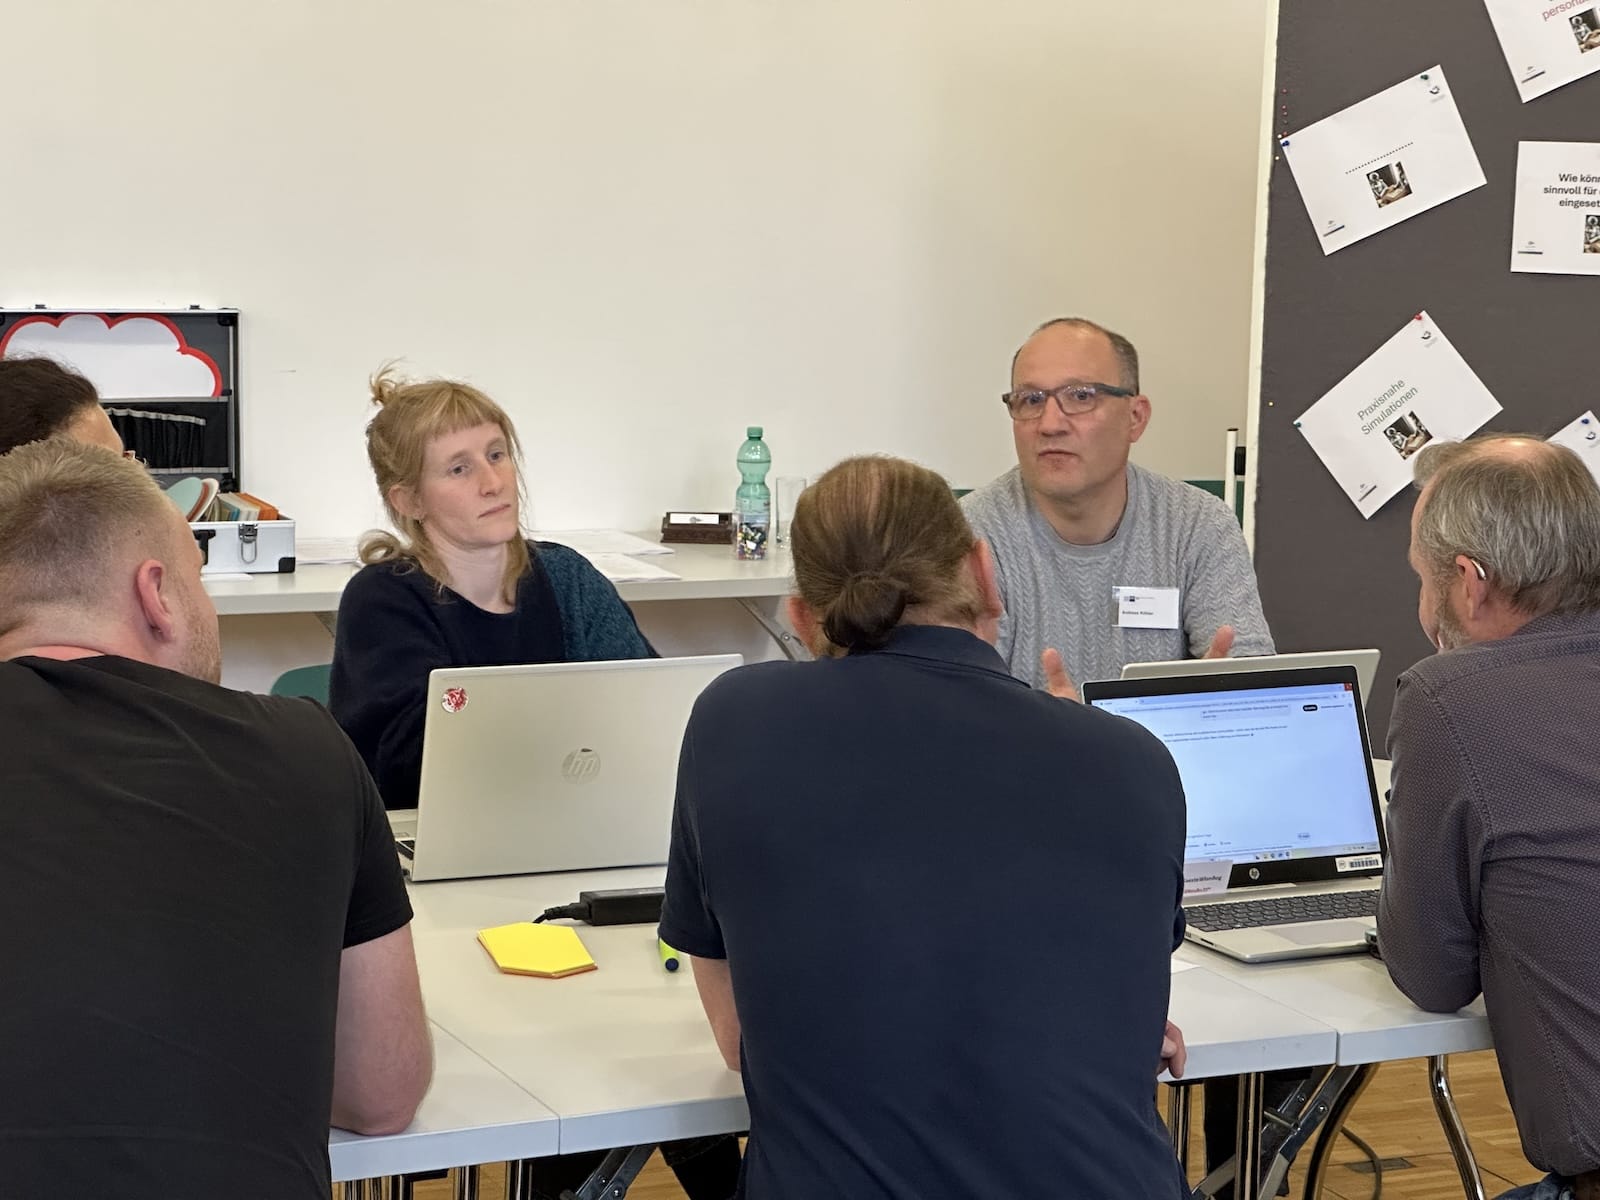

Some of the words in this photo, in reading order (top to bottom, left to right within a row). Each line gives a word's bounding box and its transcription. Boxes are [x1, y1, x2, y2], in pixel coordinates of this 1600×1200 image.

[1543, 185, 1581, 195] sinnvoll
[1583, 186, 1598, 195] für
[1558, 173, 1578, 183] Wie
[1357, 379, 1405, 421] Praxisnahe
[1361, 387, 1418, 435] Simulationen
[566, 749, 599, 784] hp
